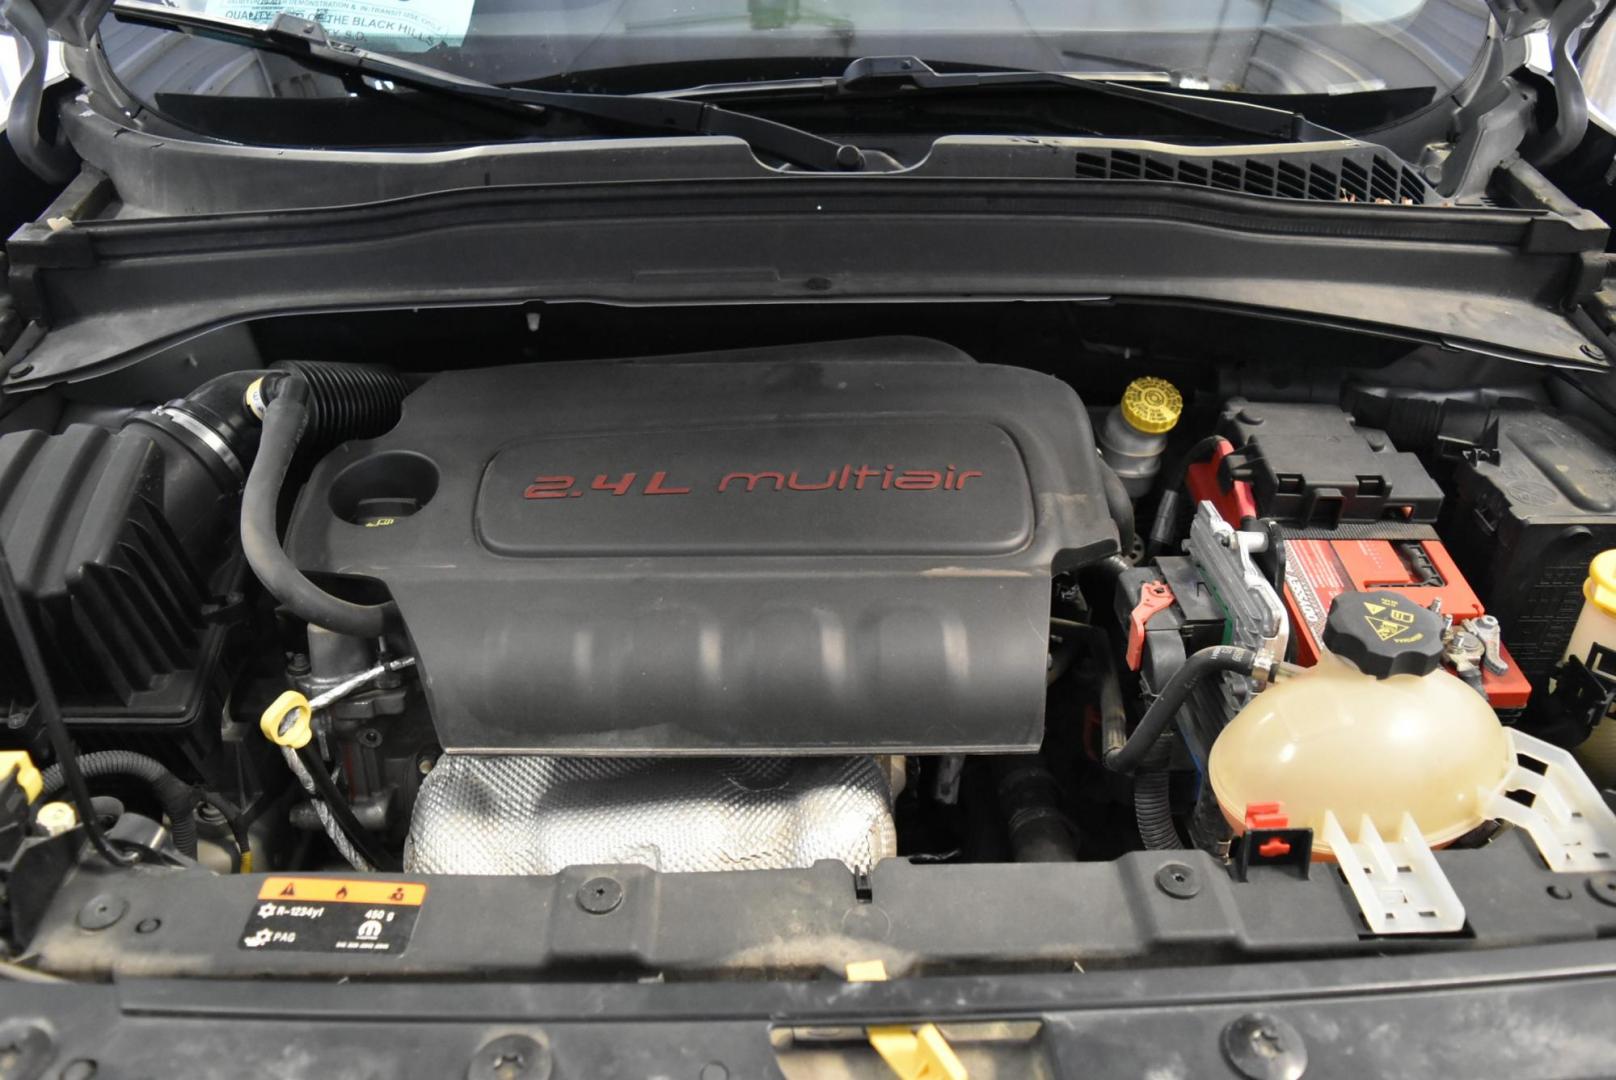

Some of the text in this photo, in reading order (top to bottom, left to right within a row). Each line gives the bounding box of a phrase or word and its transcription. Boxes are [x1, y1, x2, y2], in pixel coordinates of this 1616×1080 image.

[328, 13, 349, 24] THE
[352, 16, 396, 31] BLACK
[398, 24, 435, 46] HILLS
[717, 464, 984, 493] multiair
